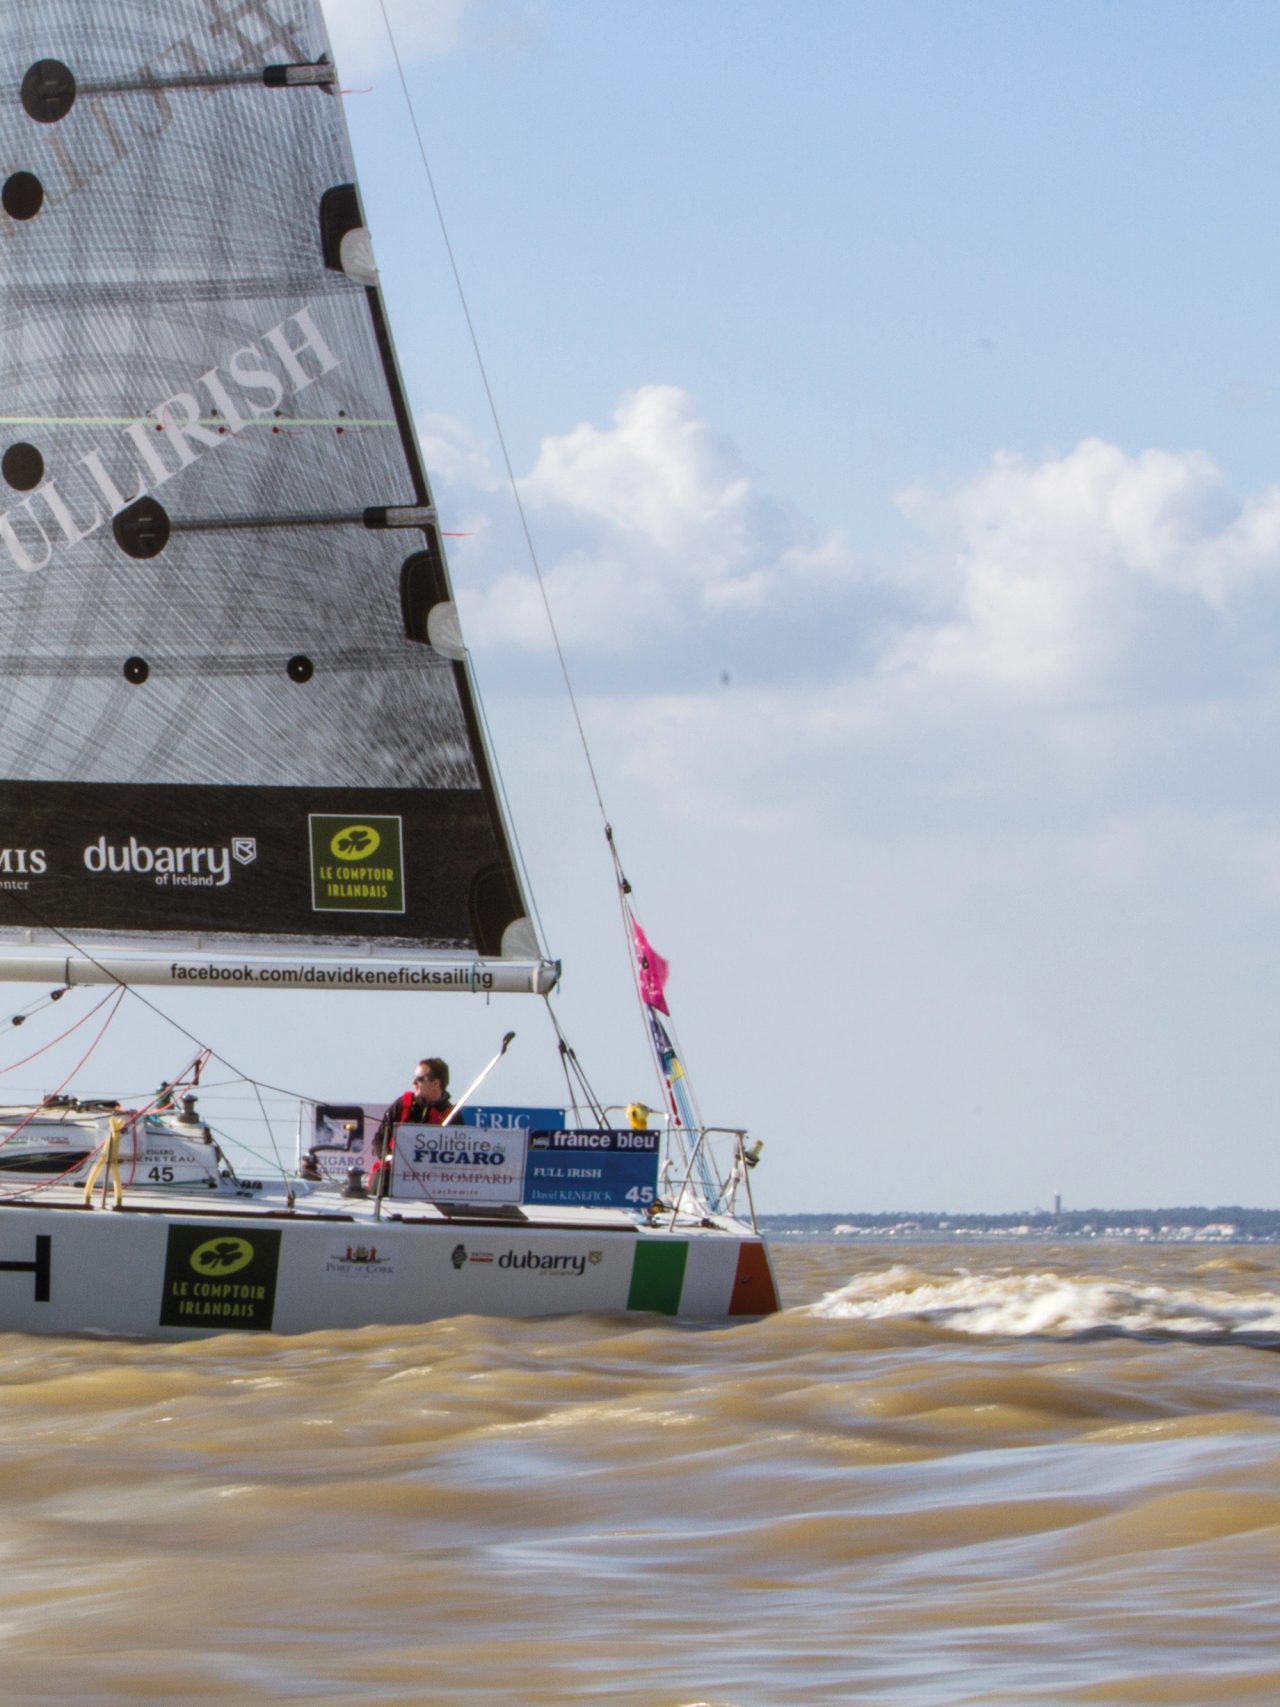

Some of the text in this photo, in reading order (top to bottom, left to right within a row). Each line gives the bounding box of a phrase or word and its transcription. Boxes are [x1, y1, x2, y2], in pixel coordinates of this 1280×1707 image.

[83, 835, 231, 886] dubarry
[155, 873, 214, 886] of Ireland
[320, 866, 394, 881] LE COMPTOIR
[327, 883, 388, 898] IRLANDAIS
[171, 963, 493, 988] facebook.com/davidkeneficksailing
[414, 1133, 491, 1152] Solitaire
[554, 1131, 611, 1148] france
[617, 1132, 655, 1149] bleu
[413, 1150, 505, 1166] FIGARO
[148, 1167, 174, 1182] 45
[402, 1171, 513, 1185] ERIC BOMPARD
[533, 1167, 602, 1179] FULL IRISH
[625, 1186, 654, 1203] 45
[498, 1250, 586, 1276] dubarry
[172, 1281, 266, 1300] LE COMPTOIR
[179, 1301, 255, 1318] IRLANDAIS
